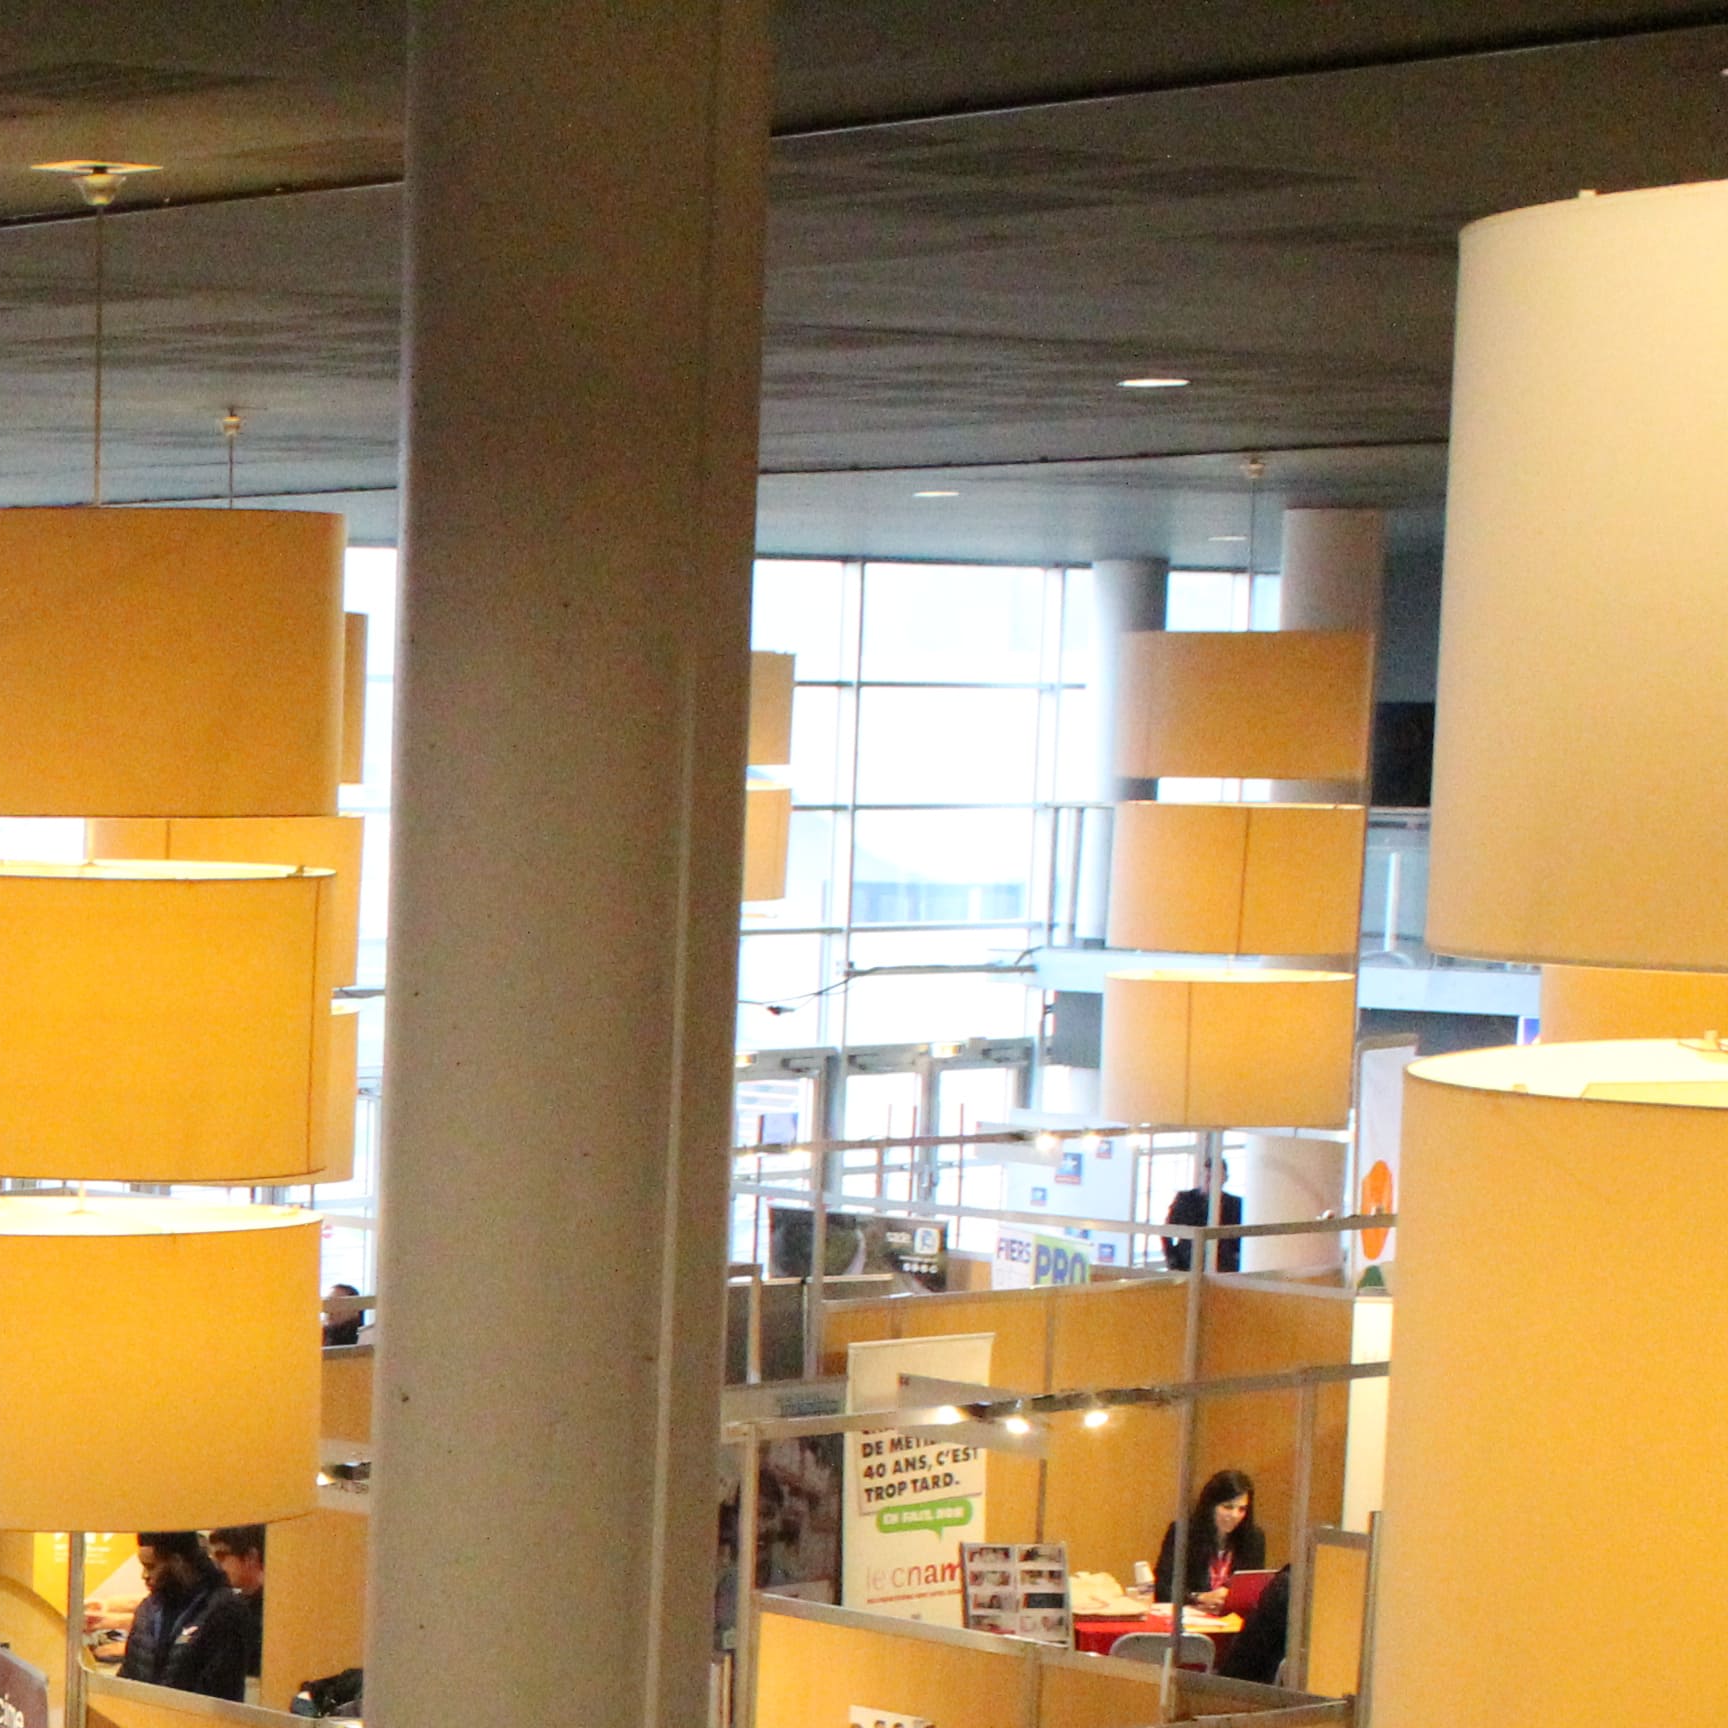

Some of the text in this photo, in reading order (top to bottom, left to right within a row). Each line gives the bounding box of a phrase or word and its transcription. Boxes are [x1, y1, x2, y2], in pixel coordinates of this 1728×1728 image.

[861, 1441, 884, 1459] DE
[863, 1446, 979, 1480] 40 ANS, C'EST
[864, 1472, 961, 1503] TROP TARD.
